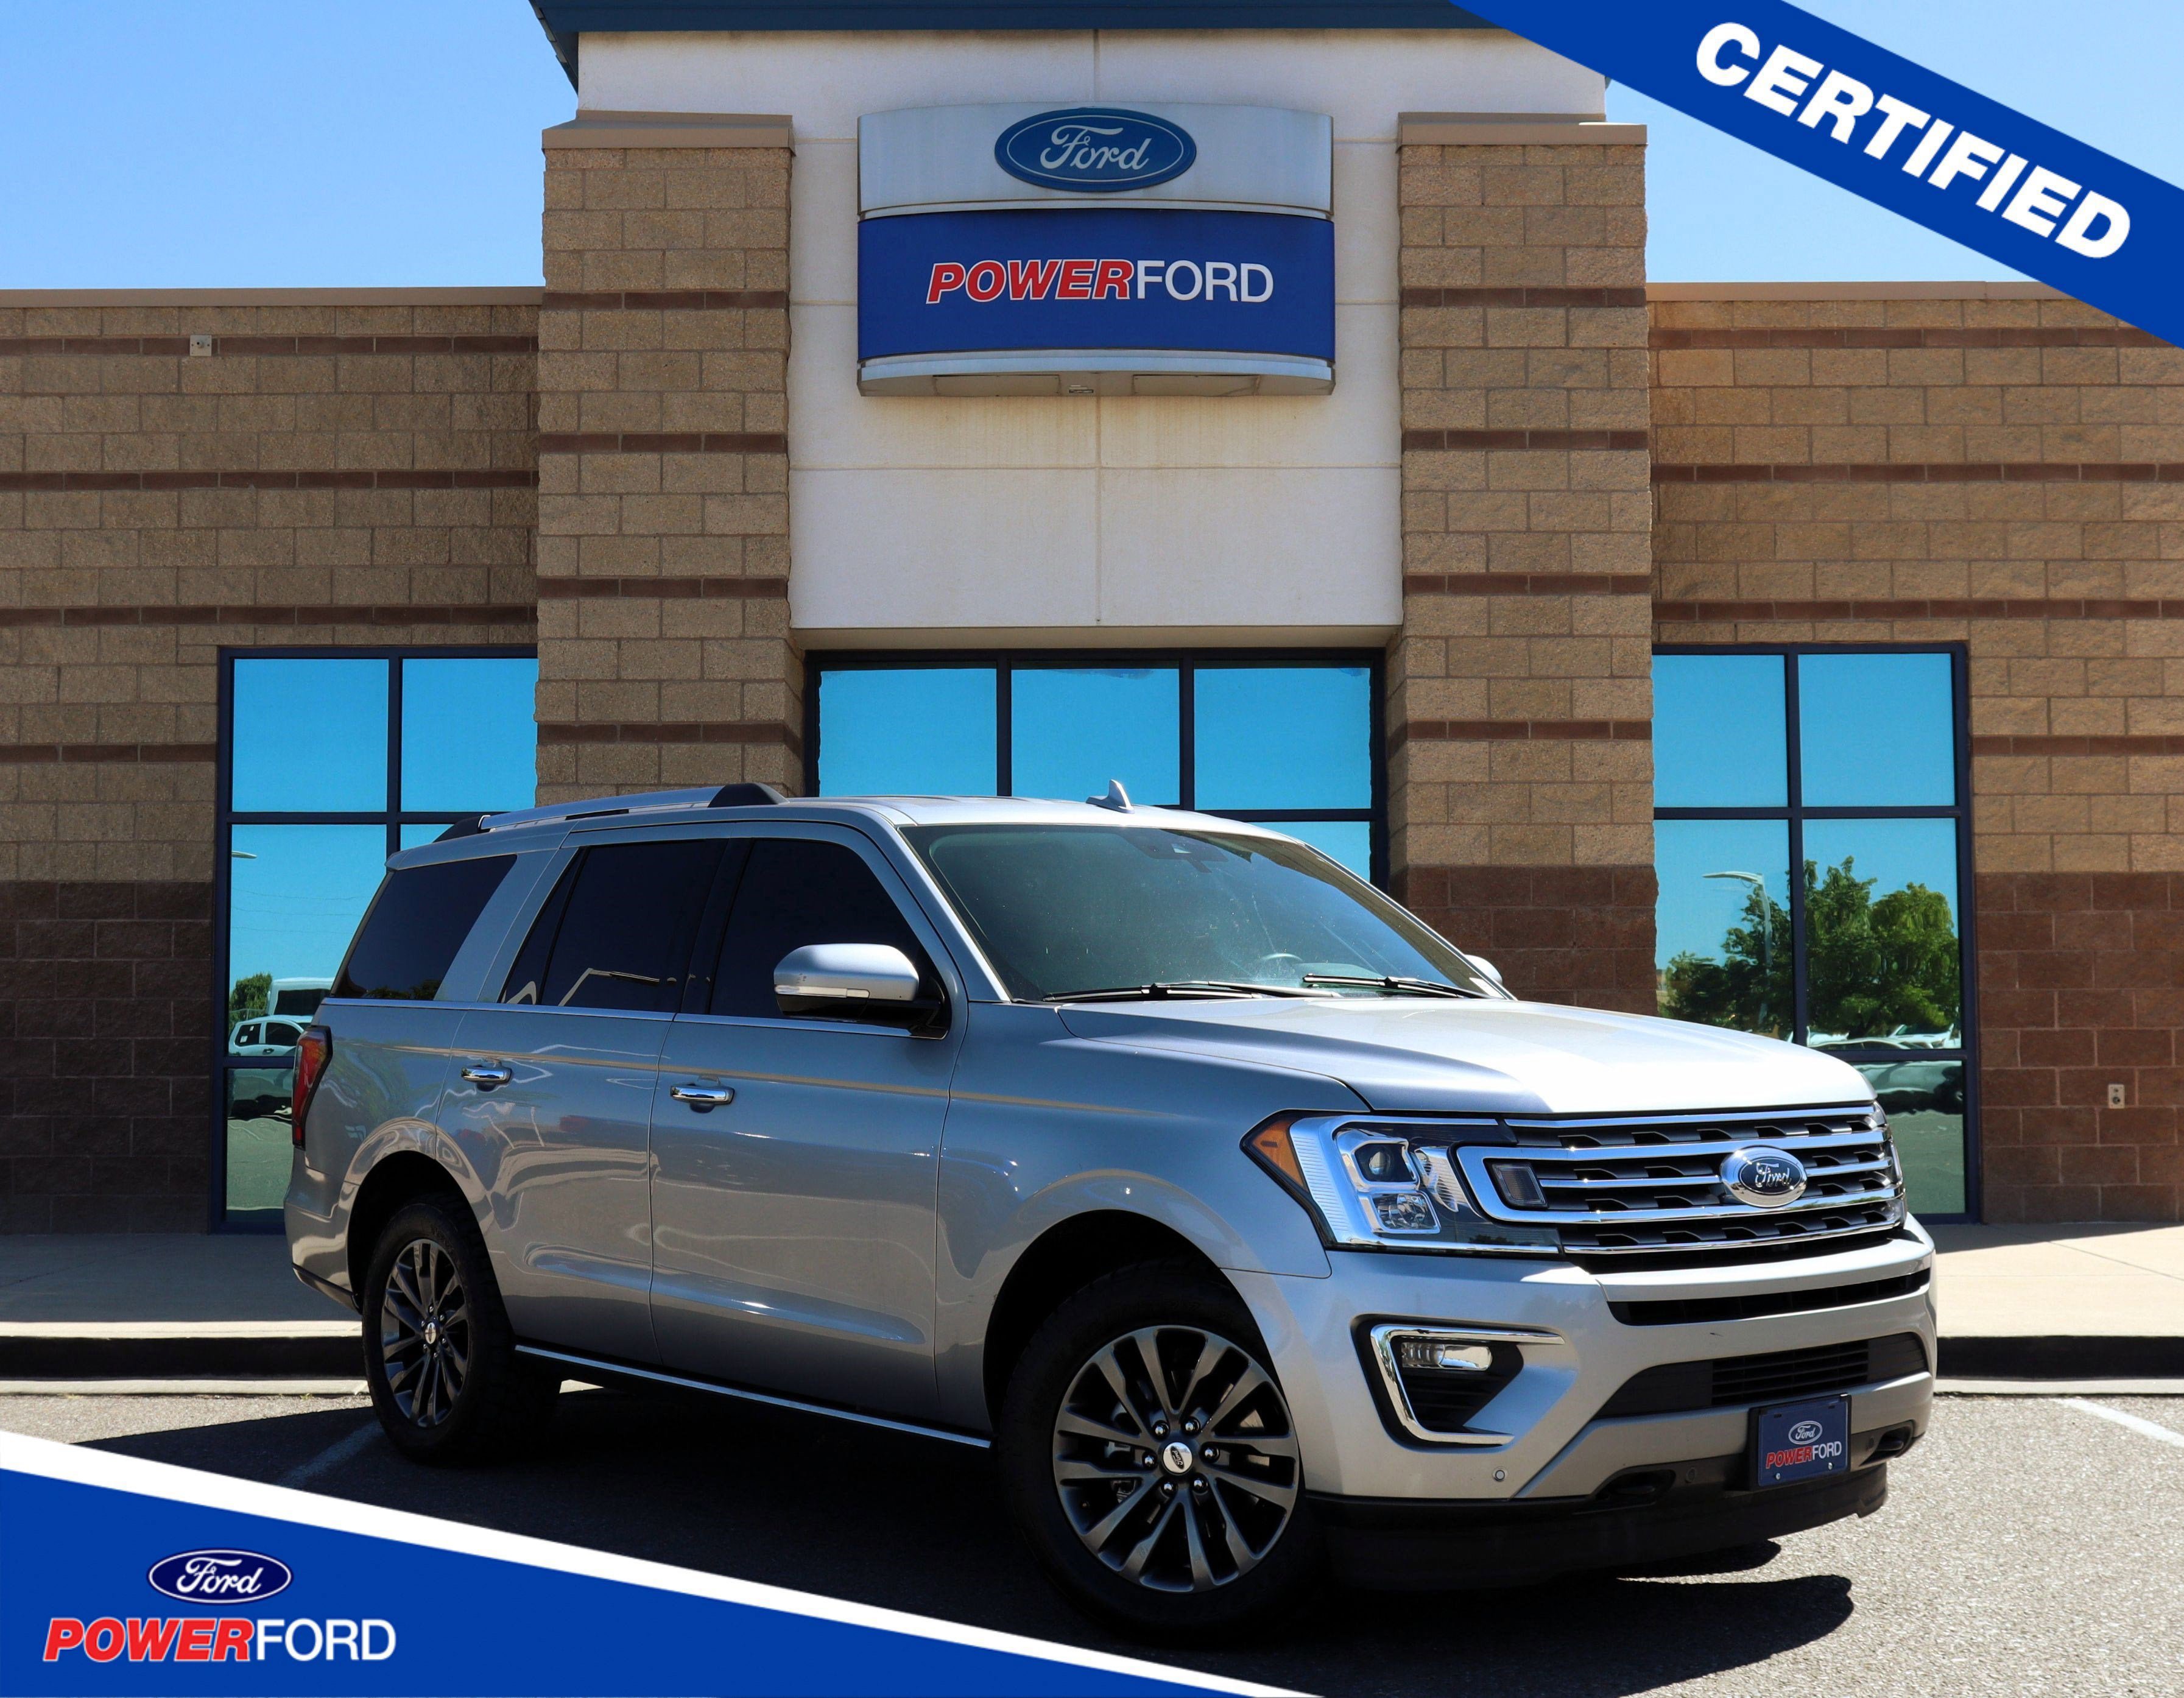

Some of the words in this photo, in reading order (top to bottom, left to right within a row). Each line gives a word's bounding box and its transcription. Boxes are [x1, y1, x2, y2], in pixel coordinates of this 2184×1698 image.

[1040, 124, 1152, 171] Ford
[1755, 1163, 1792, 1188] Ford
[1795, 1425, 1816, 1440] Ford
